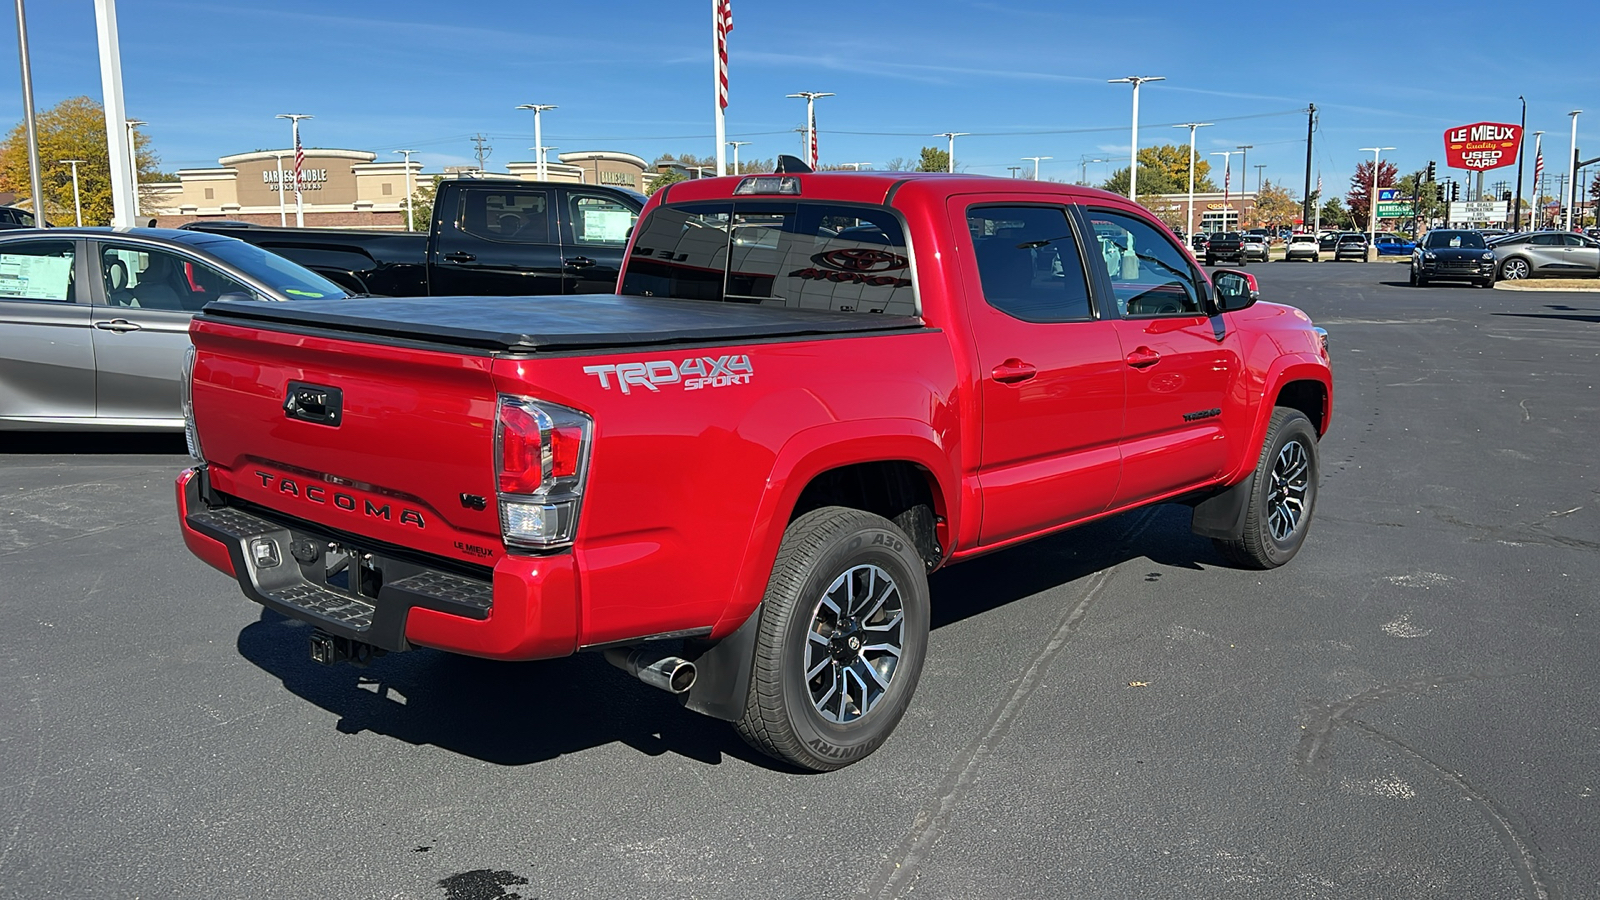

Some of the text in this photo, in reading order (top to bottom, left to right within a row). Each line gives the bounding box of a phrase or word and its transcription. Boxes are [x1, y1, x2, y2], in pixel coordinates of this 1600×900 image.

[1451, 125, 1515, 142] LE MIEUX
[1466, 142, 1497, 150] Quality
[1462, 151, 1502, 160] USED
[1465, 159, 1498, 168] CARS
[263, 169, 327, 183] BARES NOBLE
[583, 360, 681, 395] TRD
[684, 373, 753, 391] SPORT
[255, 471, 426, 529] TACOMA
[453, 541, 494, 557] LE MIEUX
[872, 534, 904, 552] A30
